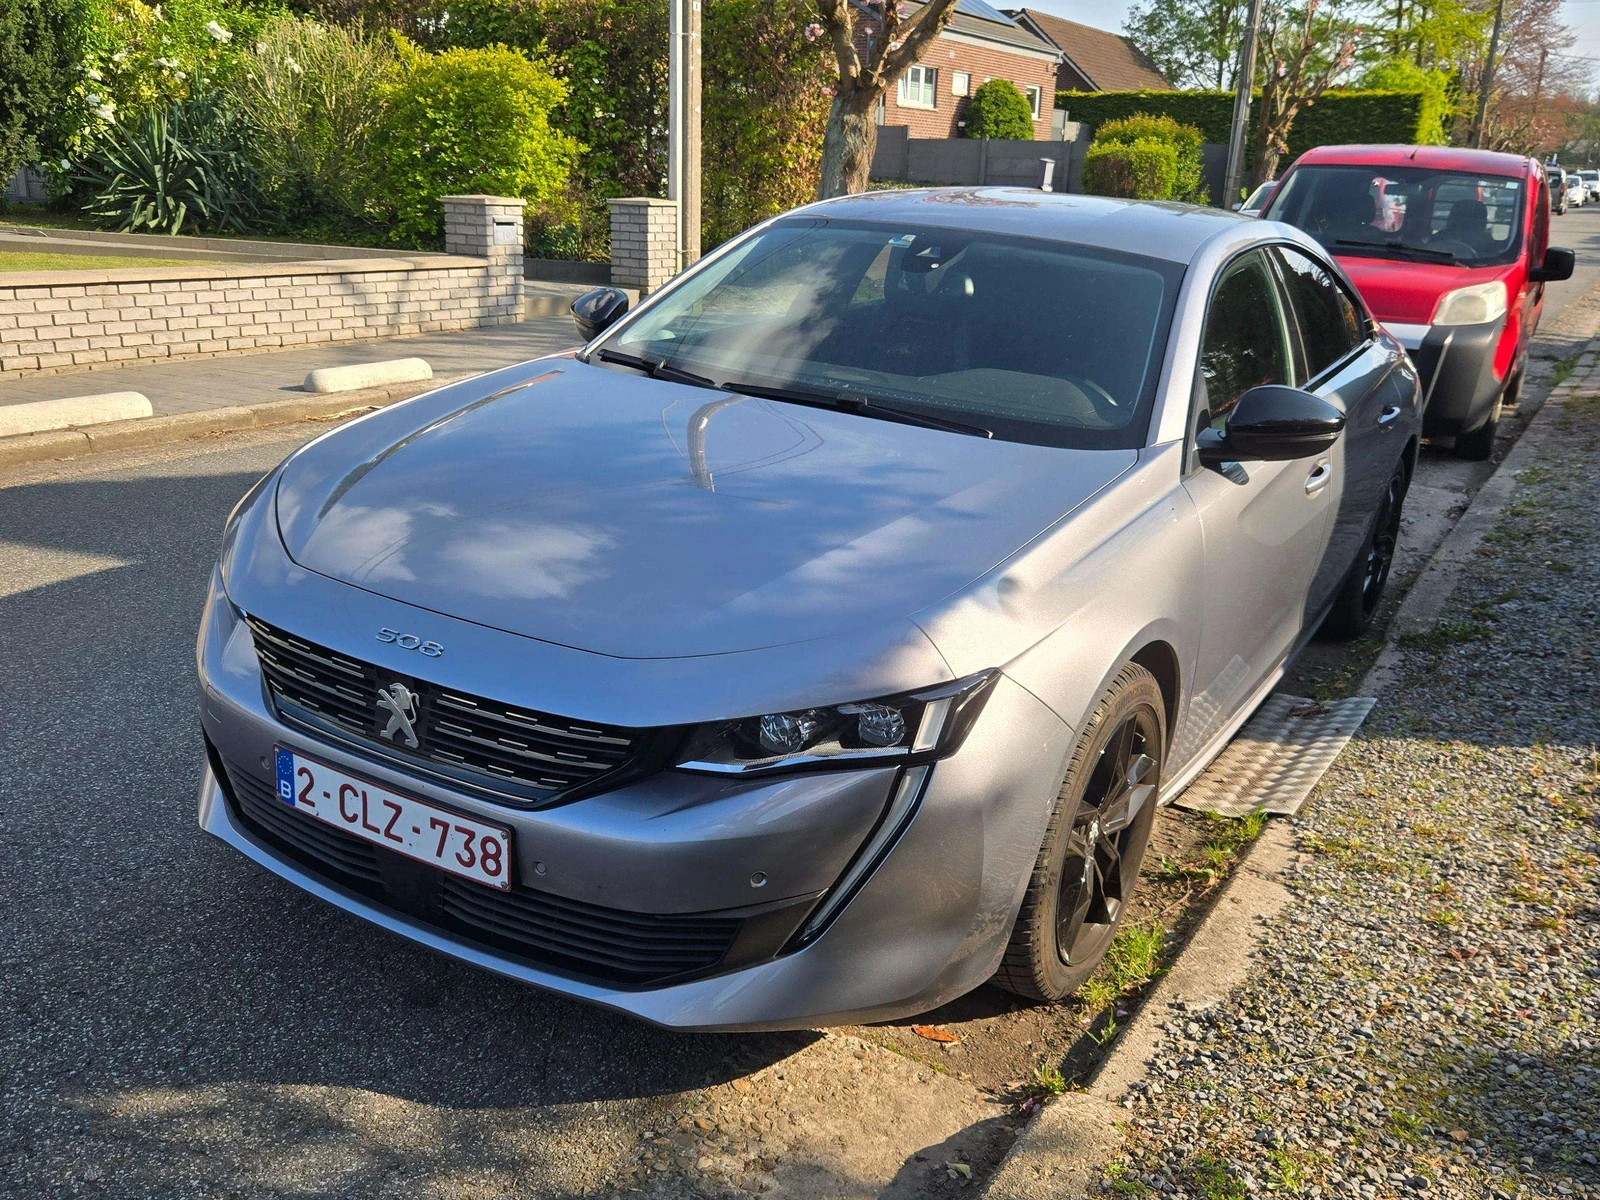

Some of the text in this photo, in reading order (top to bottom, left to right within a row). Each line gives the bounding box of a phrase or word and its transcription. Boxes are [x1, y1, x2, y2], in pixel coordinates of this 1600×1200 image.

[375, 627, 445, 658] 508
[280, 779, 292, 799] B
[297, 766, 502, 877] 2-CLZ-738
